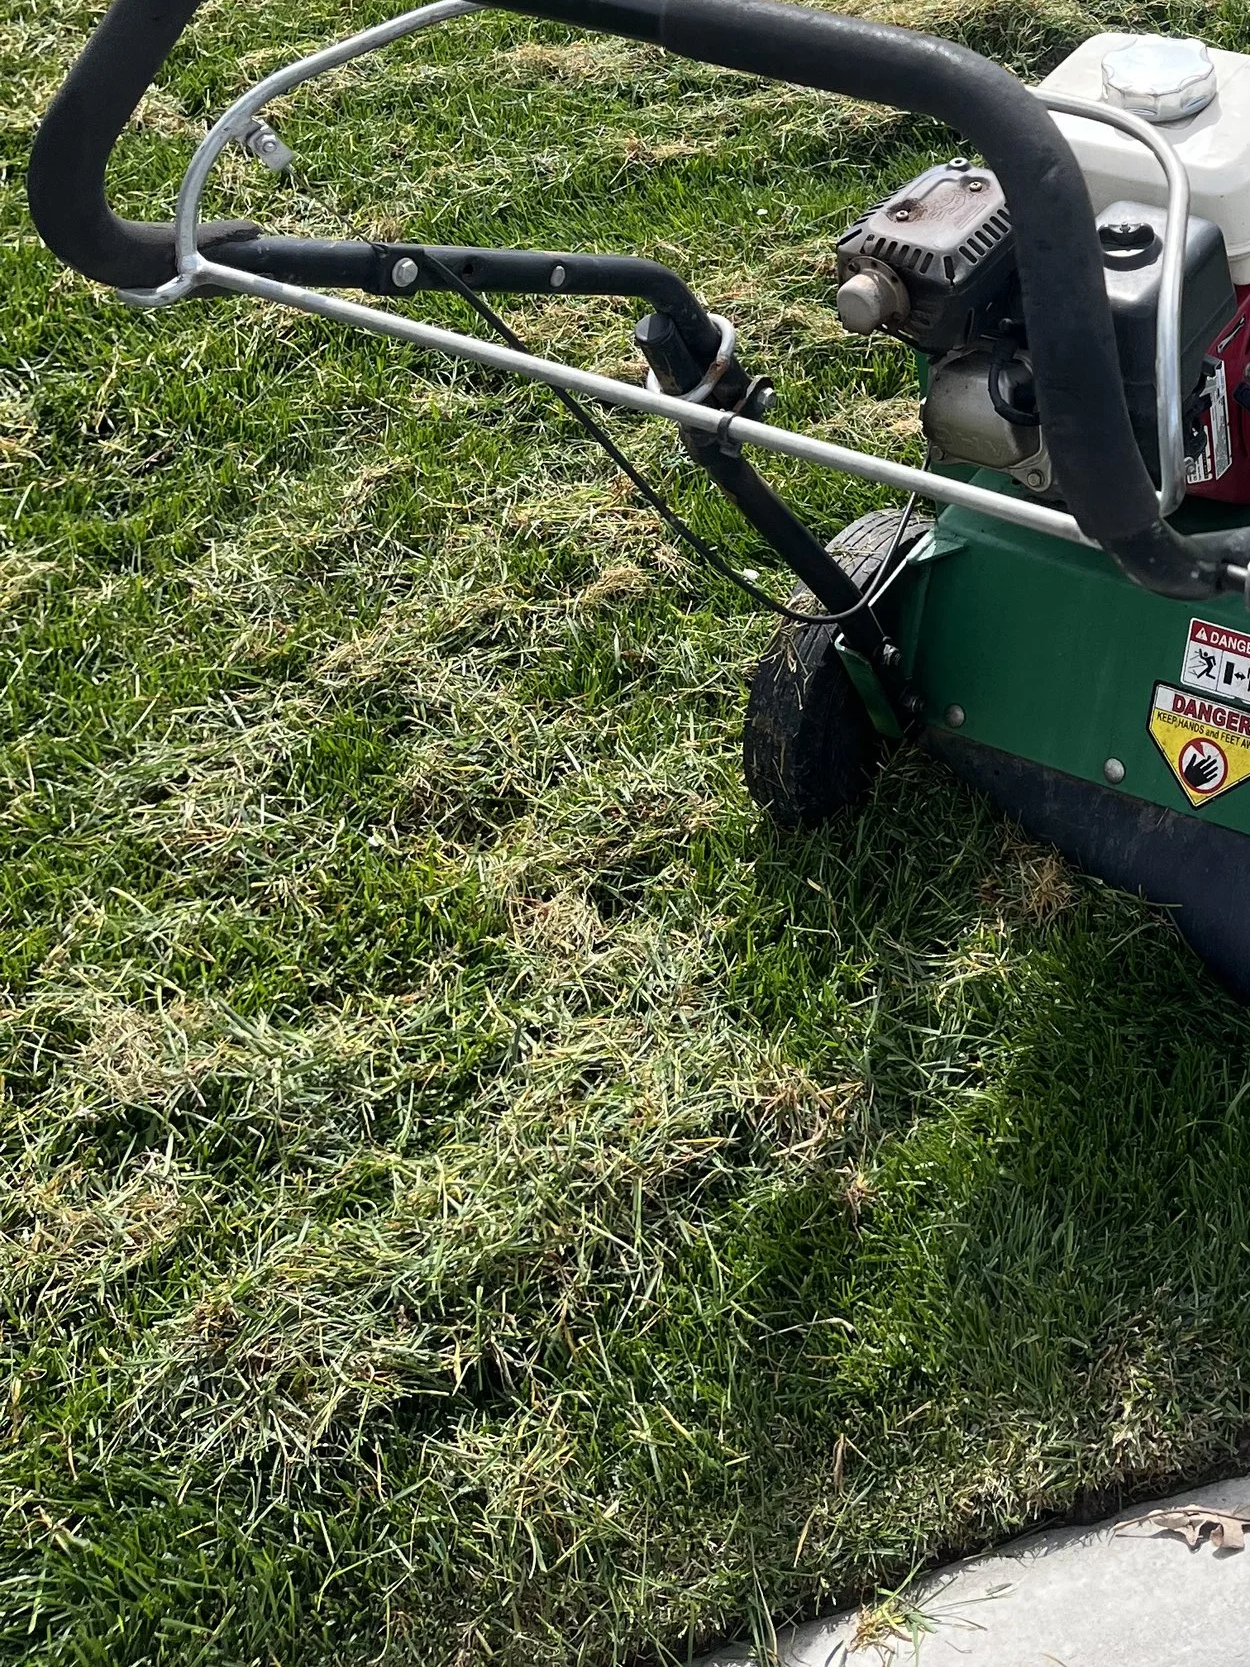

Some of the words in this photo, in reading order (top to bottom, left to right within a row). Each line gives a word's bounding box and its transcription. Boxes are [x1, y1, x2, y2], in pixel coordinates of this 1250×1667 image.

[1156, 711, 1178, 725] KEEP
[1177, 718, 1205, 735] HANDS
[1205, 728, 1220, 740] and
[1220, 732, 1241, 746] FEET
